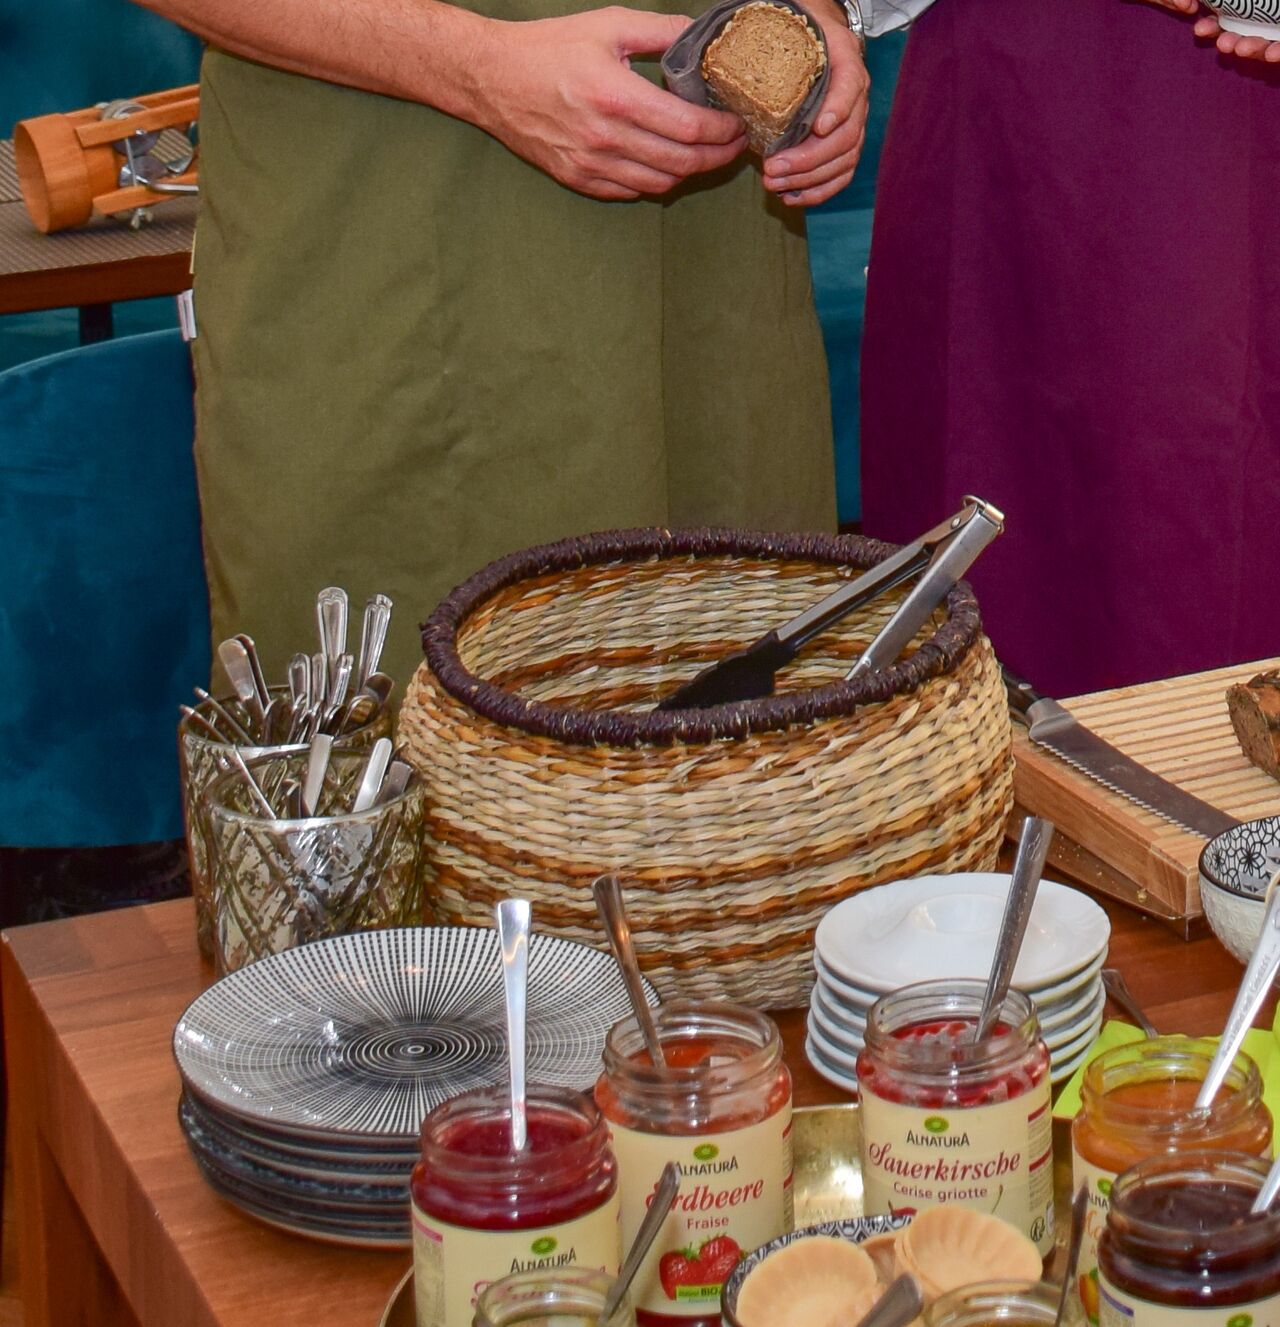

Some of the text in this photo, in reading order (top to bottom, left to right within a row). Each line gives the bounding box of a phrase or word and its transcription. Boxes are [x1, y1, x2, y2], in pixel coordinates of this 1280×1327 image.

[869, 1142, 1021, 1182] Sauerkirsche
[893, 1181, 988, 1203] Cerise griotte
[686, 1215, 730, 1230] Fraise
